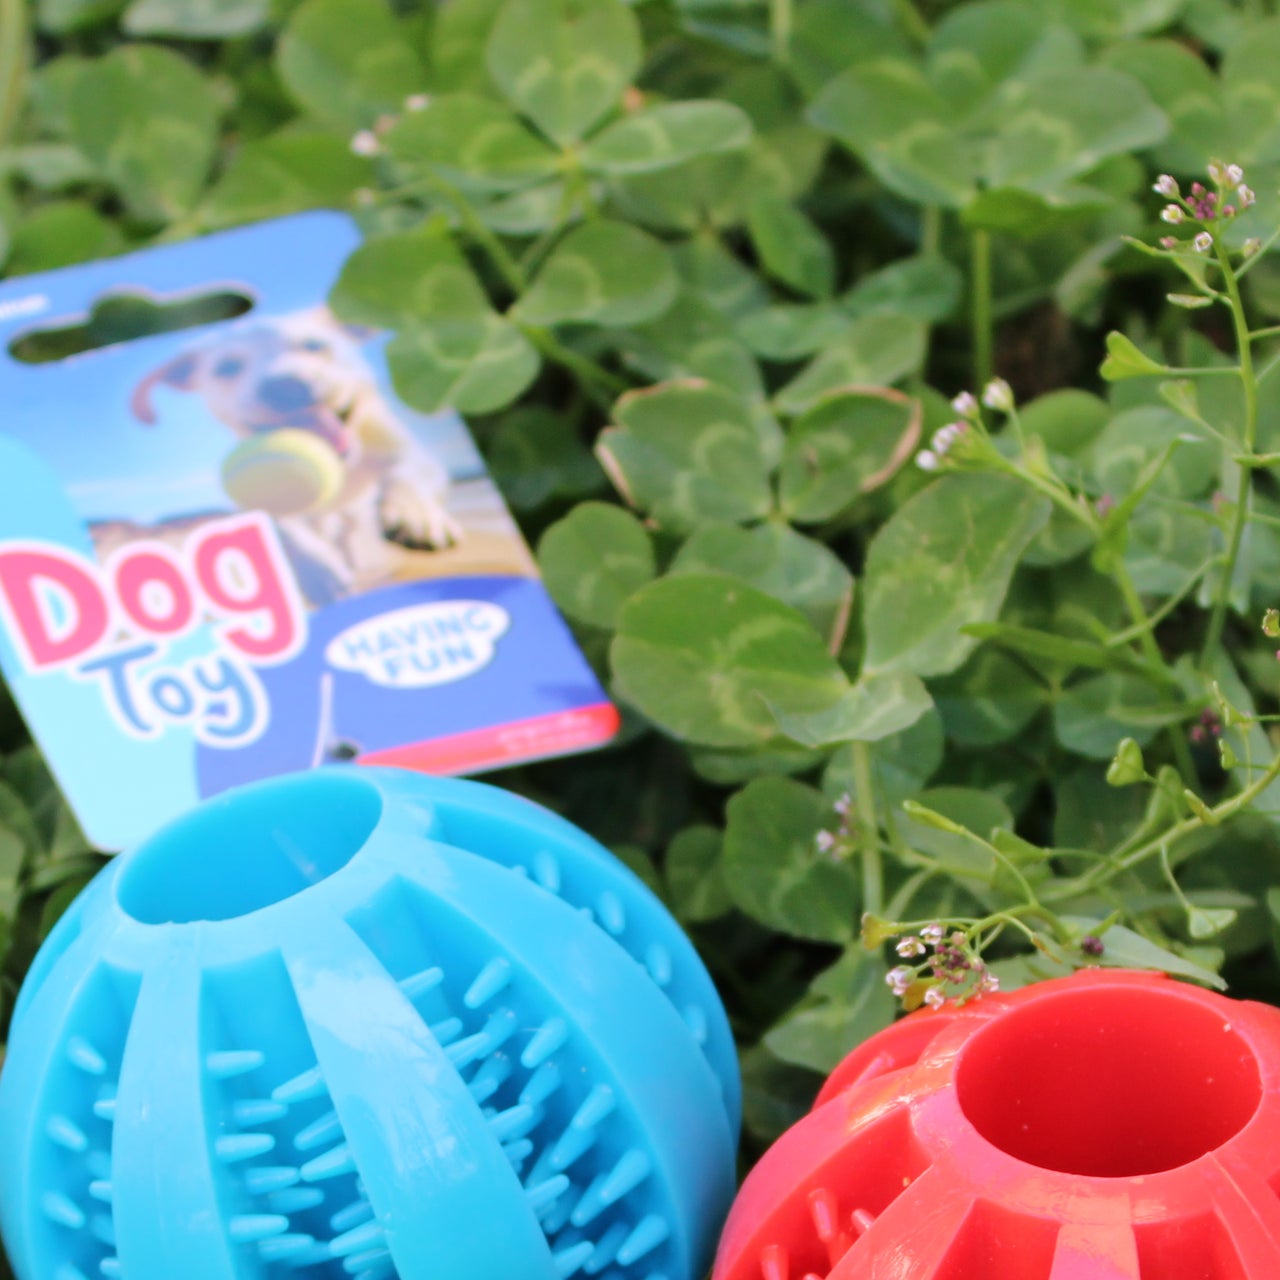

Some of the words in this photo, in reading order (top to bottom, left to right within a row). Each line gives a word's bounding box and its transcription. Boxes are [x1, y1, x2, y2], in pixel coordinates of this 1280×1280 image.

[342, 606, 493, 662] HAVING
[372, 639, 477, 679] FUN
[75, 641, 259, 740] Toy
